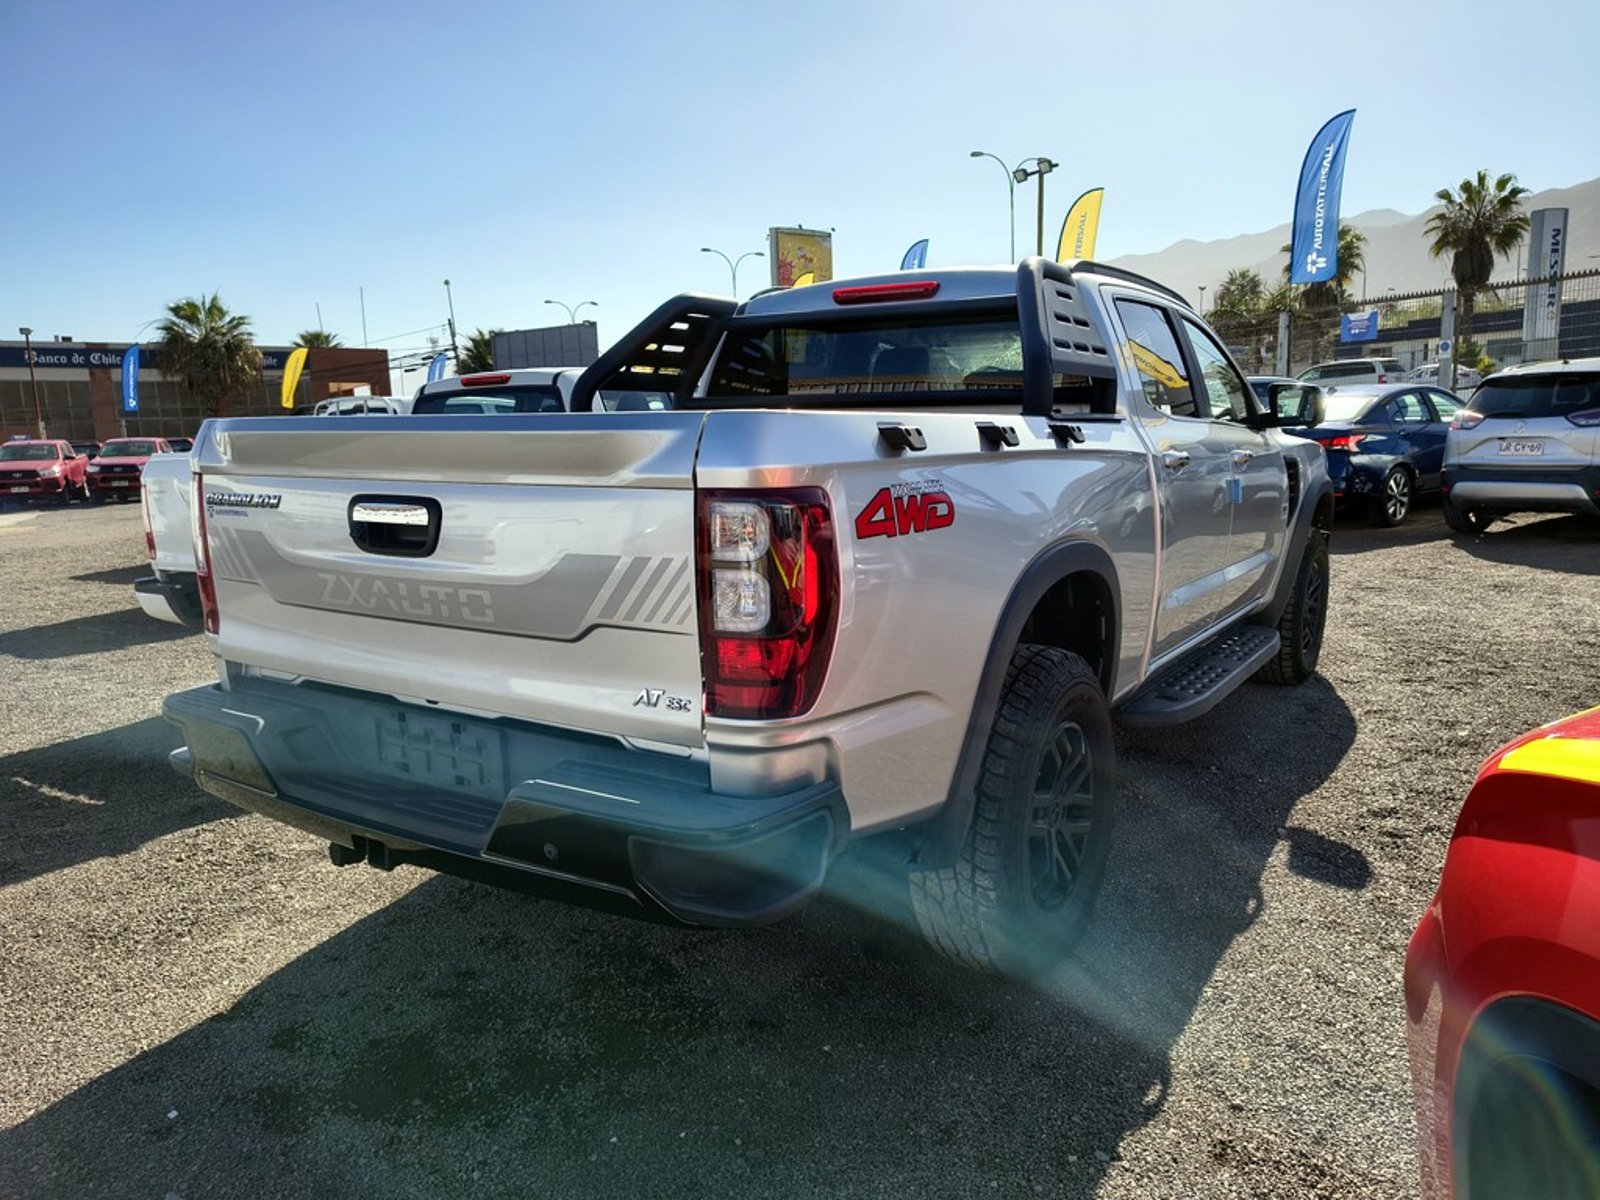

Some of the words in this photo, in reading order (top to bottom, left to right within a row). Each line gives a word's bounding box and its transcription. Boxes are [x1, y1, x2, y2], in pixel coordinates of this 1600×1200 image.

[1313, 143, 1334, 250] AUTOTATTERSALL
[24, 350, 68, 364] Banco
[71, 353, 86, 364] de
[90, 352, 122, 365] Chile
[855, 487, 955, 539] 4WD
[317, 573, 496, 622] ZXAUTO
[633, 688, 666, 708] AT
